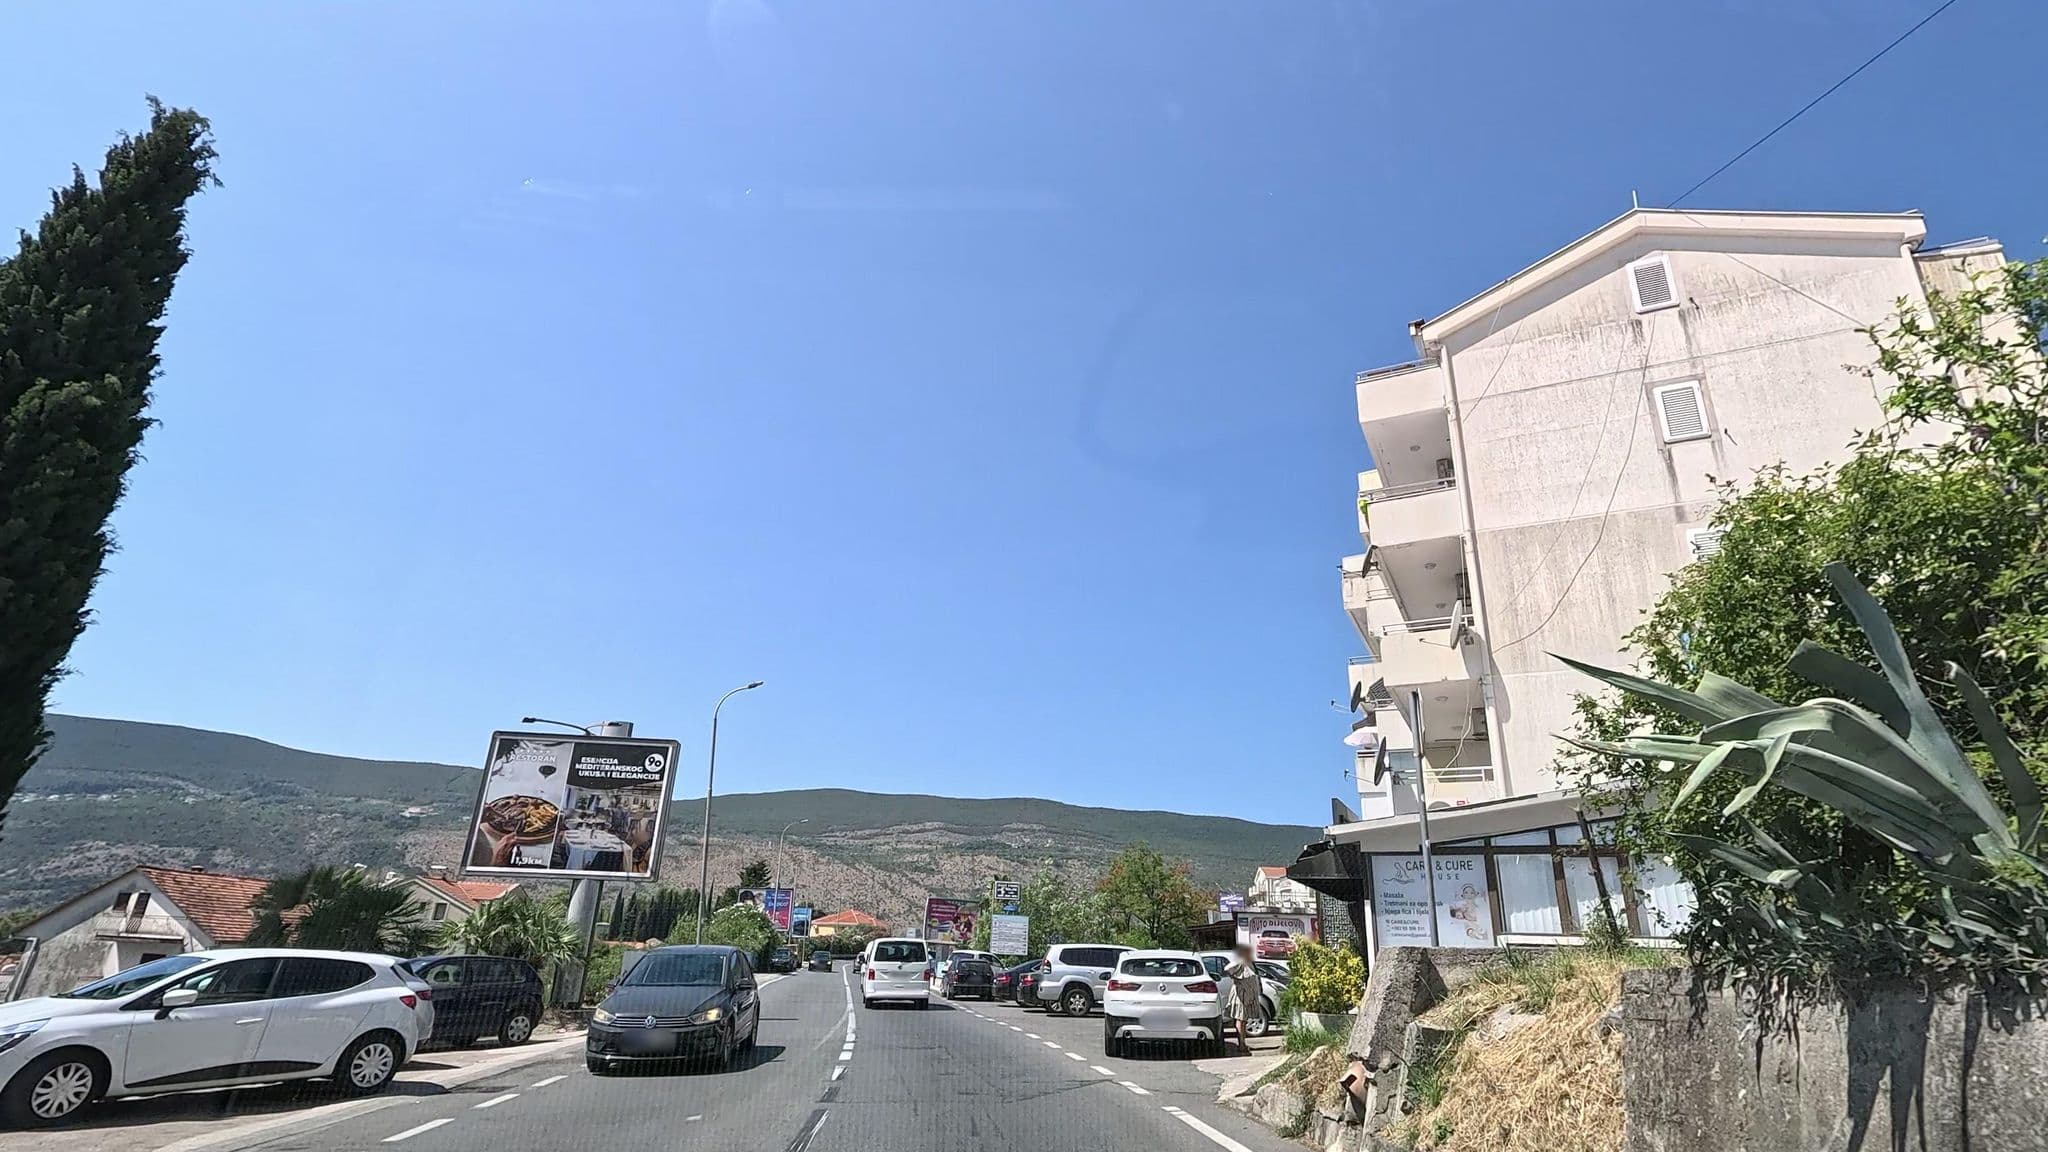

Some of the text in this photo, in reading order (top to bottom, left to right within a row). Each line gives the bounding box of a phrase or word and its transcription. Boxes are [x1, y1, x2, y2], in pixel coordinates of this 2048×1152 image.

[575, 763, 643, 772] MEDITERANSKOG
[579, 770, 606, 778] UKUSA
[612, 772, 660, 780] ELEGANCIJE
[1405, 860, 1473, 871] CAR & CURE
[1421, 873, 1460, 881] HUSE
